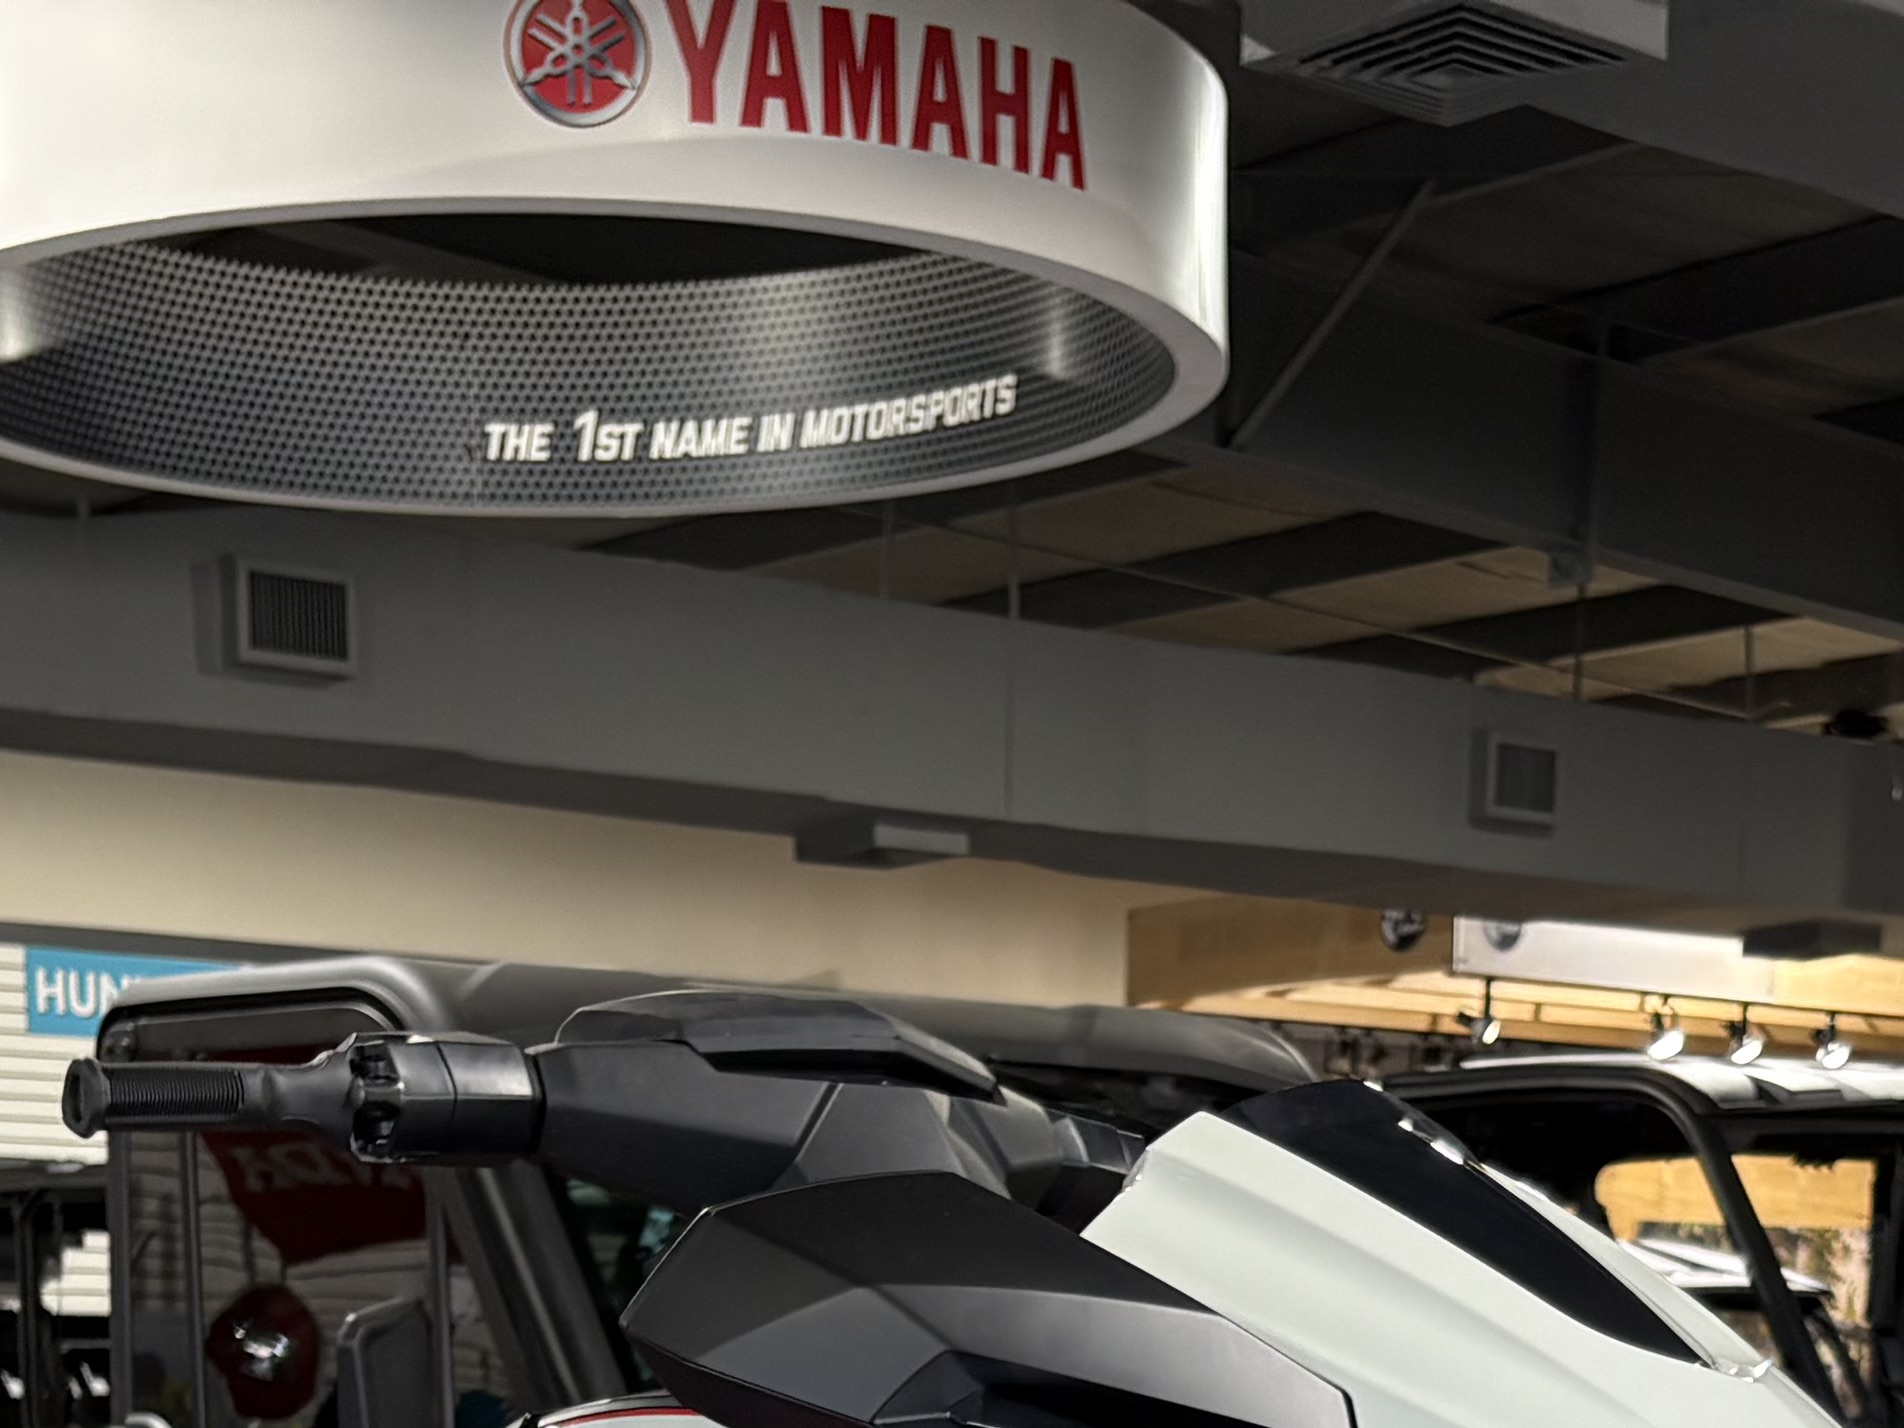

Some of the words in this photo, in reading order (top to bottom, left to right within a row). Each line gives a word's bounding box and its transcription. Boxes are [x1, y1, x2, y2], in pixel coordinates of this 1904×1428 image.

[664, 0, 1085, 191] YAMAHA
[485, 422, 555, 462] THE
[574, 409, 645, 462] 1ST
[649, 415, 753, 460] NAME
[756, 411, 795, 452] IN
[799, 373, 1018, 449] MOTORSPORTS
[35, 966, 142, 1018] HUN
